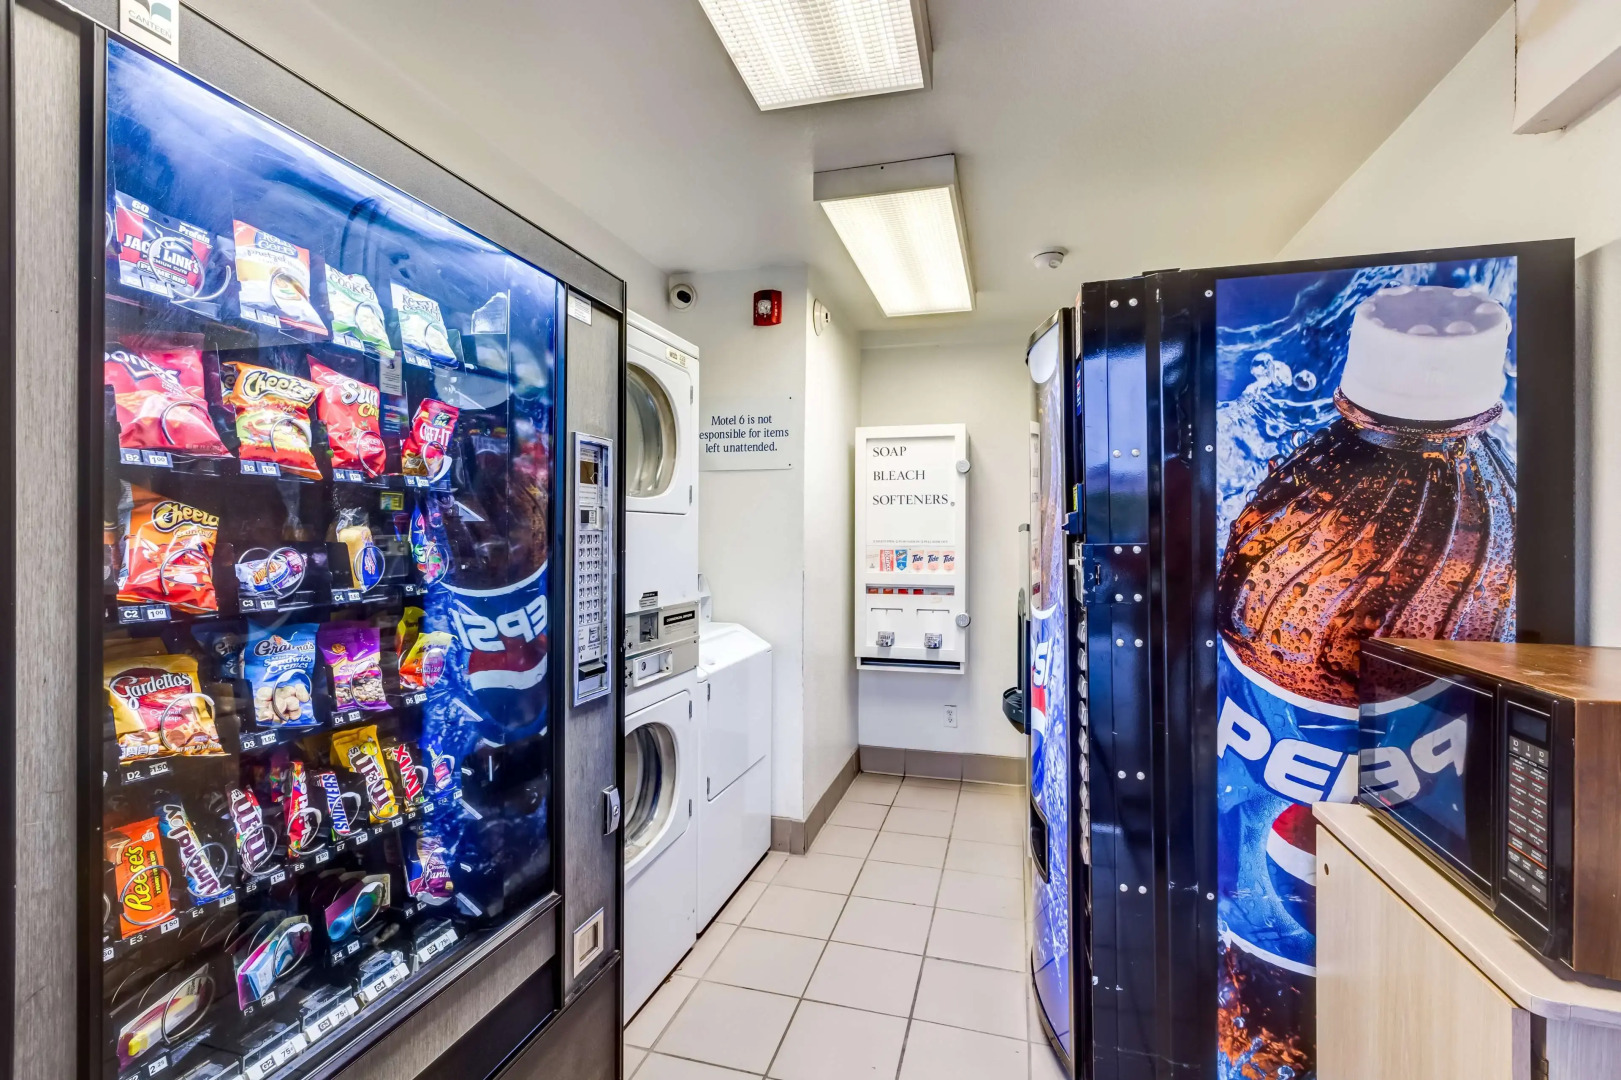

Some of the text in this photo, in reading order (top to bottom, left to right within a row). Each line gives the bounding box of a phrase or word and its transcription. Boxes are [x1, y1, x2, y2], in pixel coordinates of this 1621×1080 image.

[128, 9, 172, 40] CANTEEN
[179, 225, 210, 244] Protein
[243, 370, 316, 401] Cheetos
[711, 415, 772, 426] Motel 6 is not
[699, 428, 789, 442] esponsible for items
[705, 442, 778, 453] left unattended.
[872, 446, 907, 457] SOAP
[125, 453, 140, 462] B2
[873, 470, 925, 481] BLEACH
[872, 494, 948, 505] SOFTENERS
[154, 502, 219, 530] Cheeto
[912, 554, 924, 564] Tide
[927, 554, 939, 564] Tide
[943, 554, 955, 564] Tide
[123, 609, 138, 618] C2
[1031, 636, 1053, 690] SI
[110, 673, 192, 710] Gardetto's
[244, 741, 255, 749] D3
[127, 771, 141, 780] D2
[394, 744, 421, 800] TWIX
[336, 843, 346, 851] E7
[295, 863, 305, 872] E6
[124, 846, 153, 911] Reese's
[246, 884, 257, 893] E5
[192, 908, 204, 917] E4
[129, 935, 143, 946] E3
[333, 951, 343, 961] F4
[243, 1008, 254, 1016] F3
[261, 1060, 274, 1072] G2
